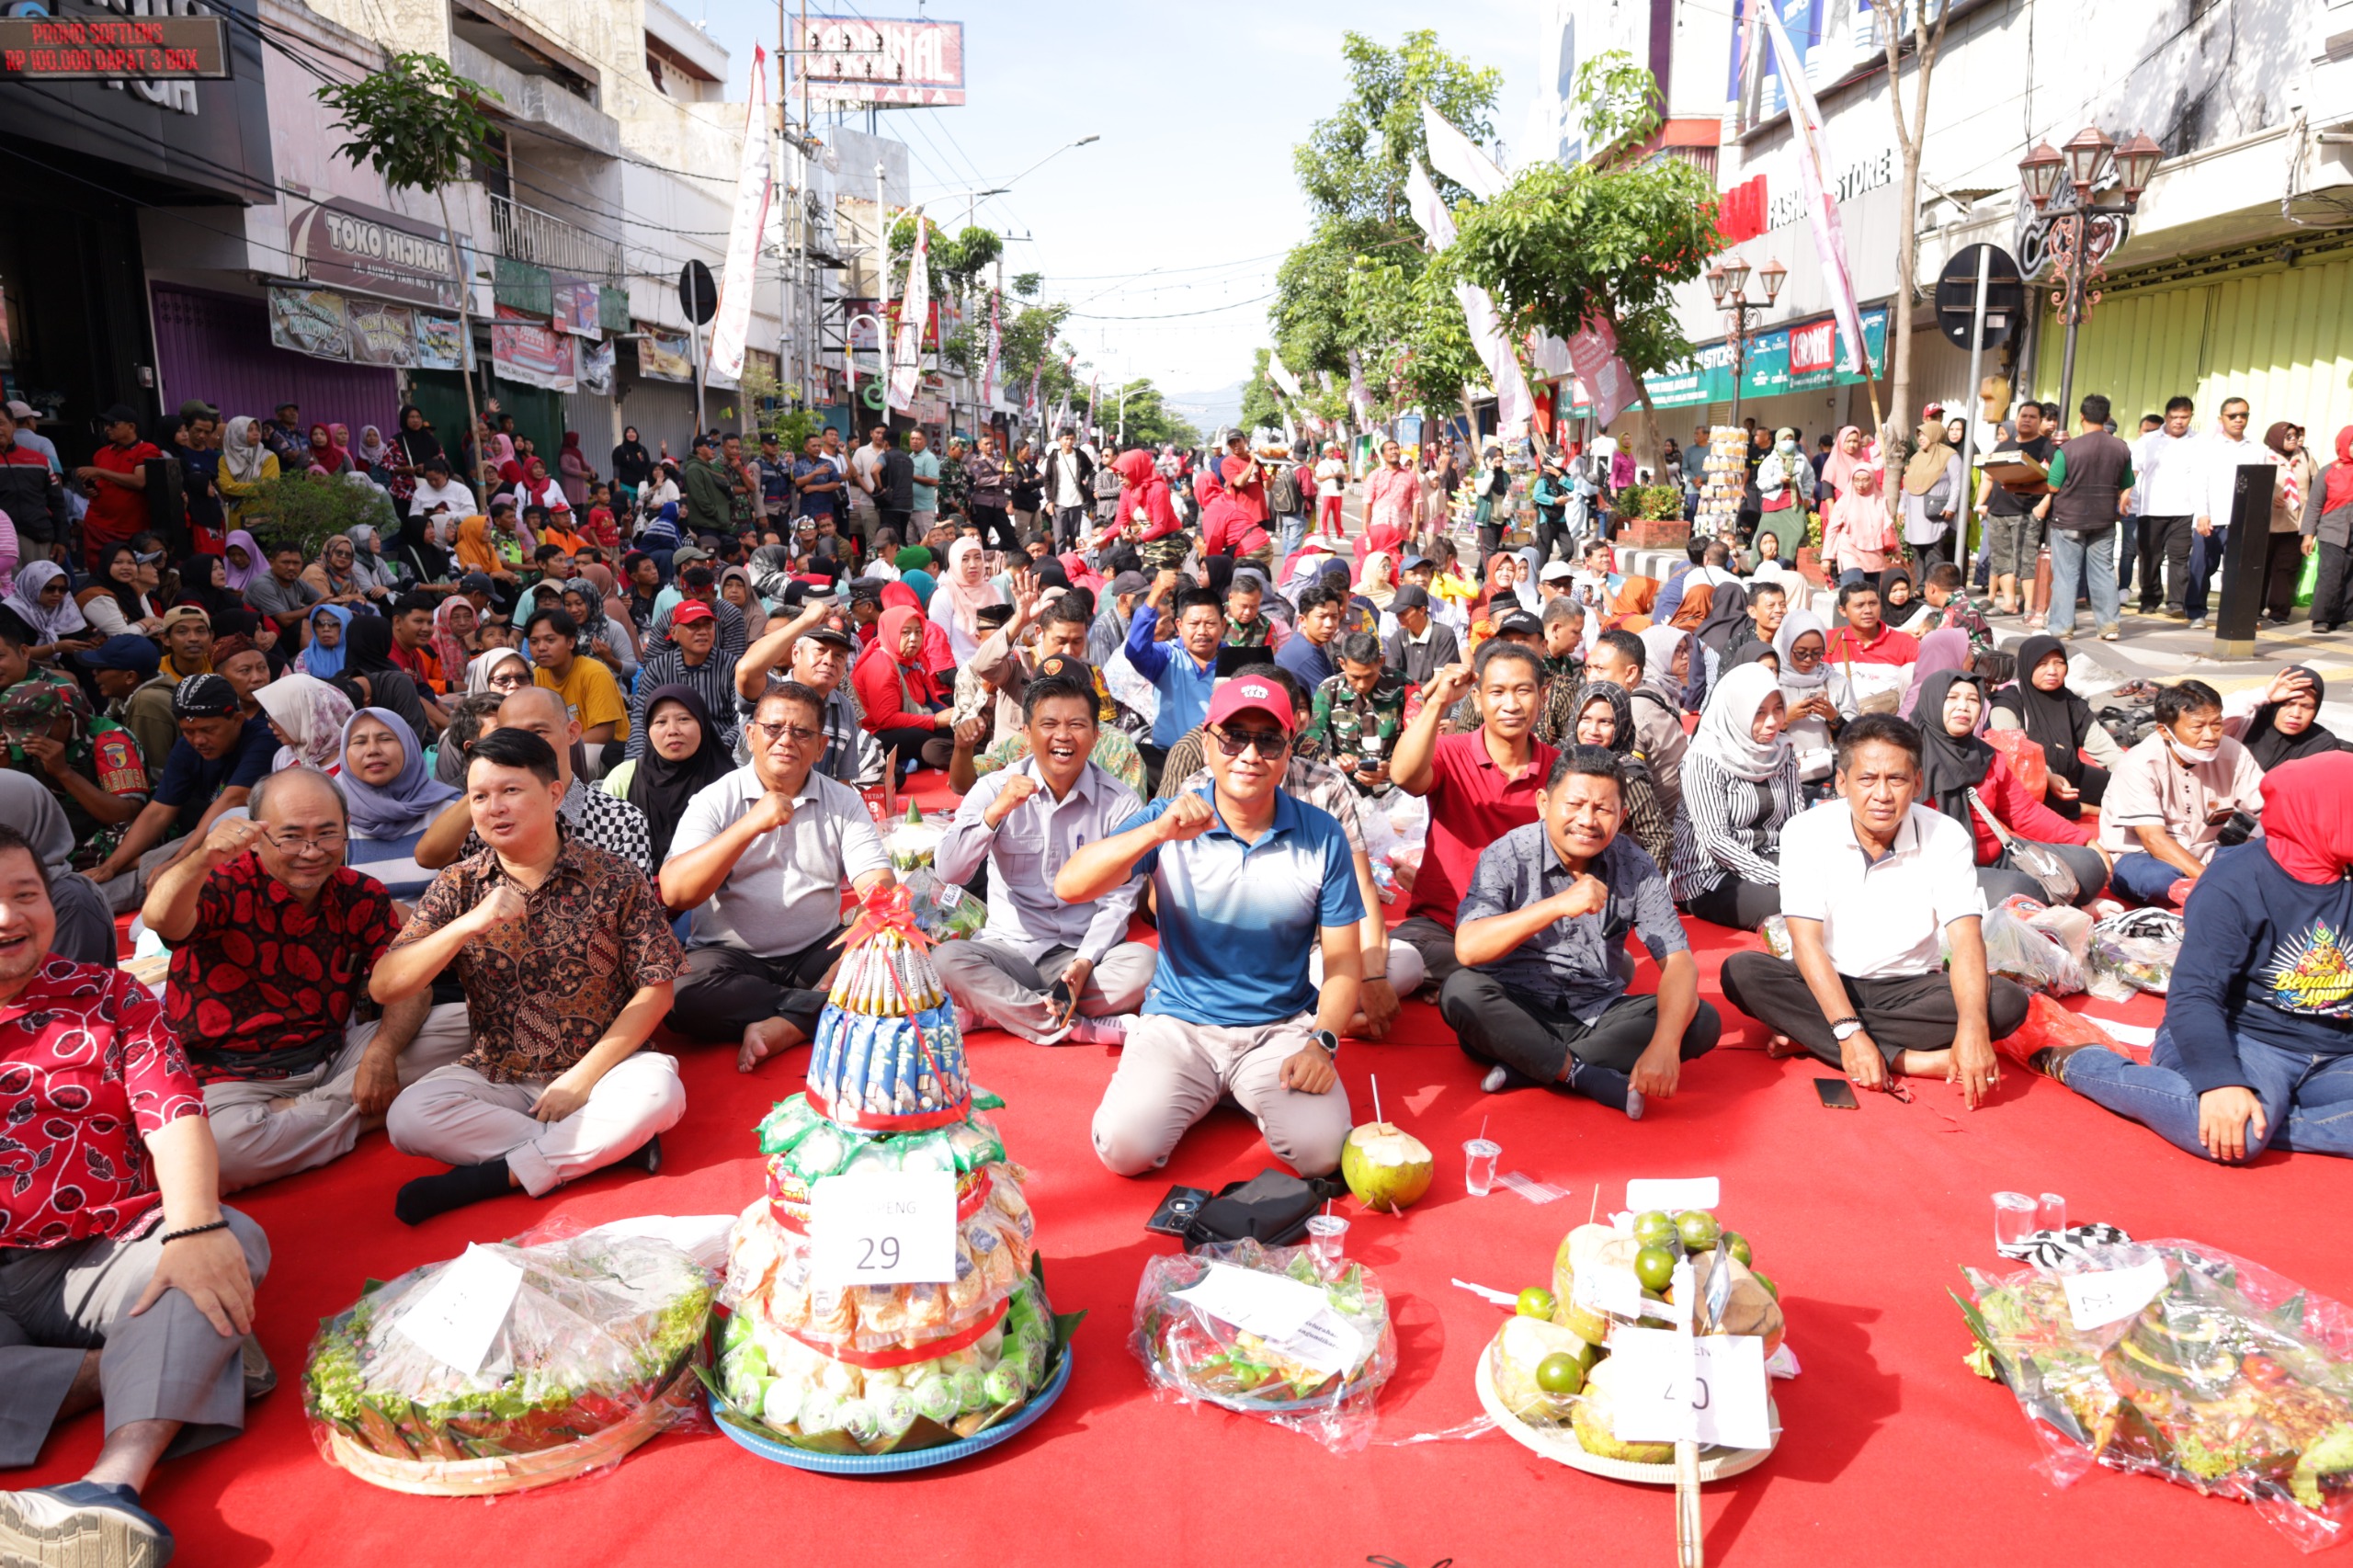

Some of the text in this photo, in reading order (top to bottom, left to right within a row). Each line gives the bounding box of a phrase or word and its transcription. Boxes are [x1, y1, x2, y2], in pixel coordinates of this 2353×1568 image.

[31, 23, 165, 45] PROMO SOFTLENS
[6, 50, 199, 72] RP 100.000 DAPAT 3 BOX
[805, 23, 955, 82] CARDINAL
[1834, 147, 1892, 205] STORE
[324, 210, 449, 275] TOKO HIJRAH
[367, 263, 396, 281] AHMAD
[397, 273, 415, 287] YANI
[429, 279, 435, 290] 9
[518, 335, 545, 348] PARTS
[1791, 325, 1832, 368] CARDINAL
[1704, 346, 1737, 369] STOR
[98, 768, 148, 793] ABINSA
[939, 1024, 956, 1068] Kalpa
[856, 1236, 901, 1270] 29
